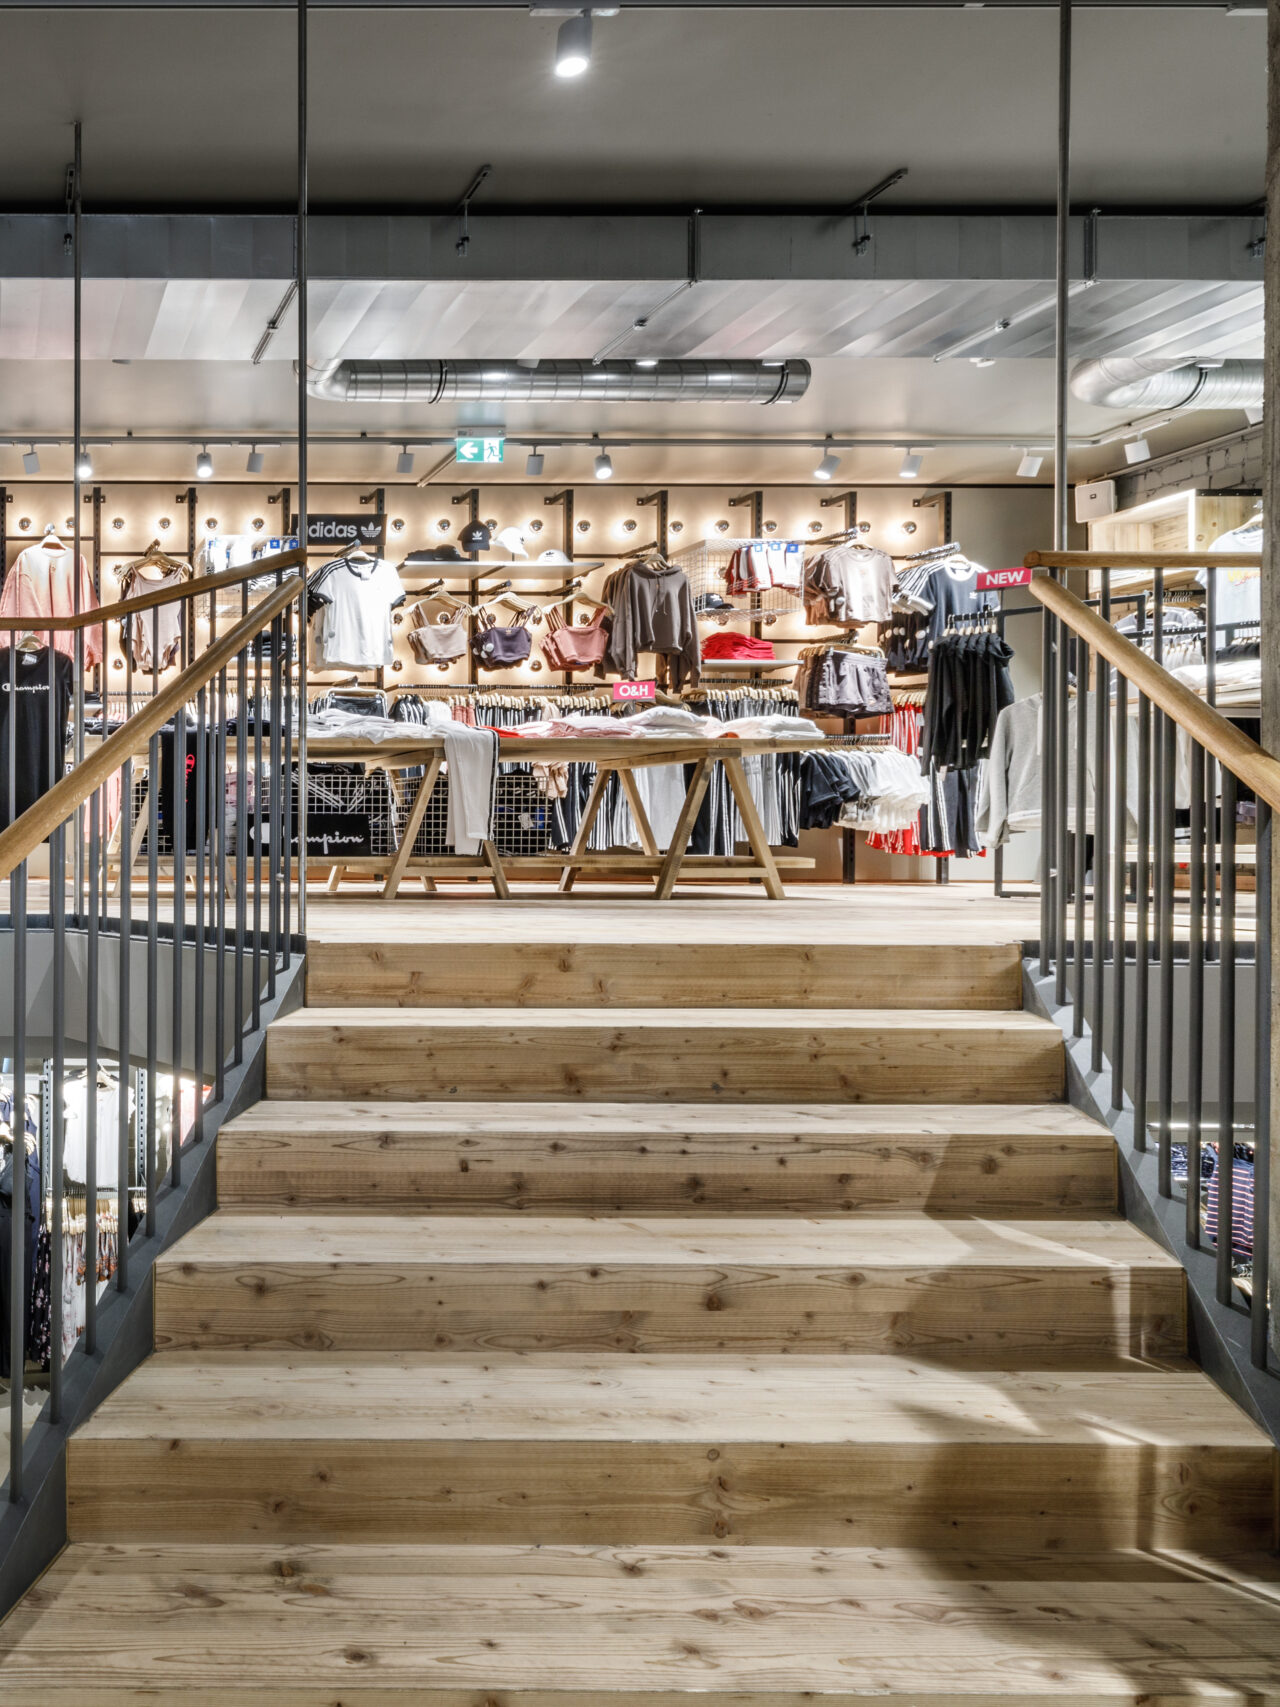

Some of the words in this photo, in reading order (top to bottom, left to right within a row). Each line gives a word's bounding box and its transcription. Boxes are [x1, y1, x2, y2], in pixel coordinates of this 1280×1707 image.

[296, 521, 357, 538] didas
[985, 570, 1024, 586] NEW
[619, 684, 648, 697] O&H
